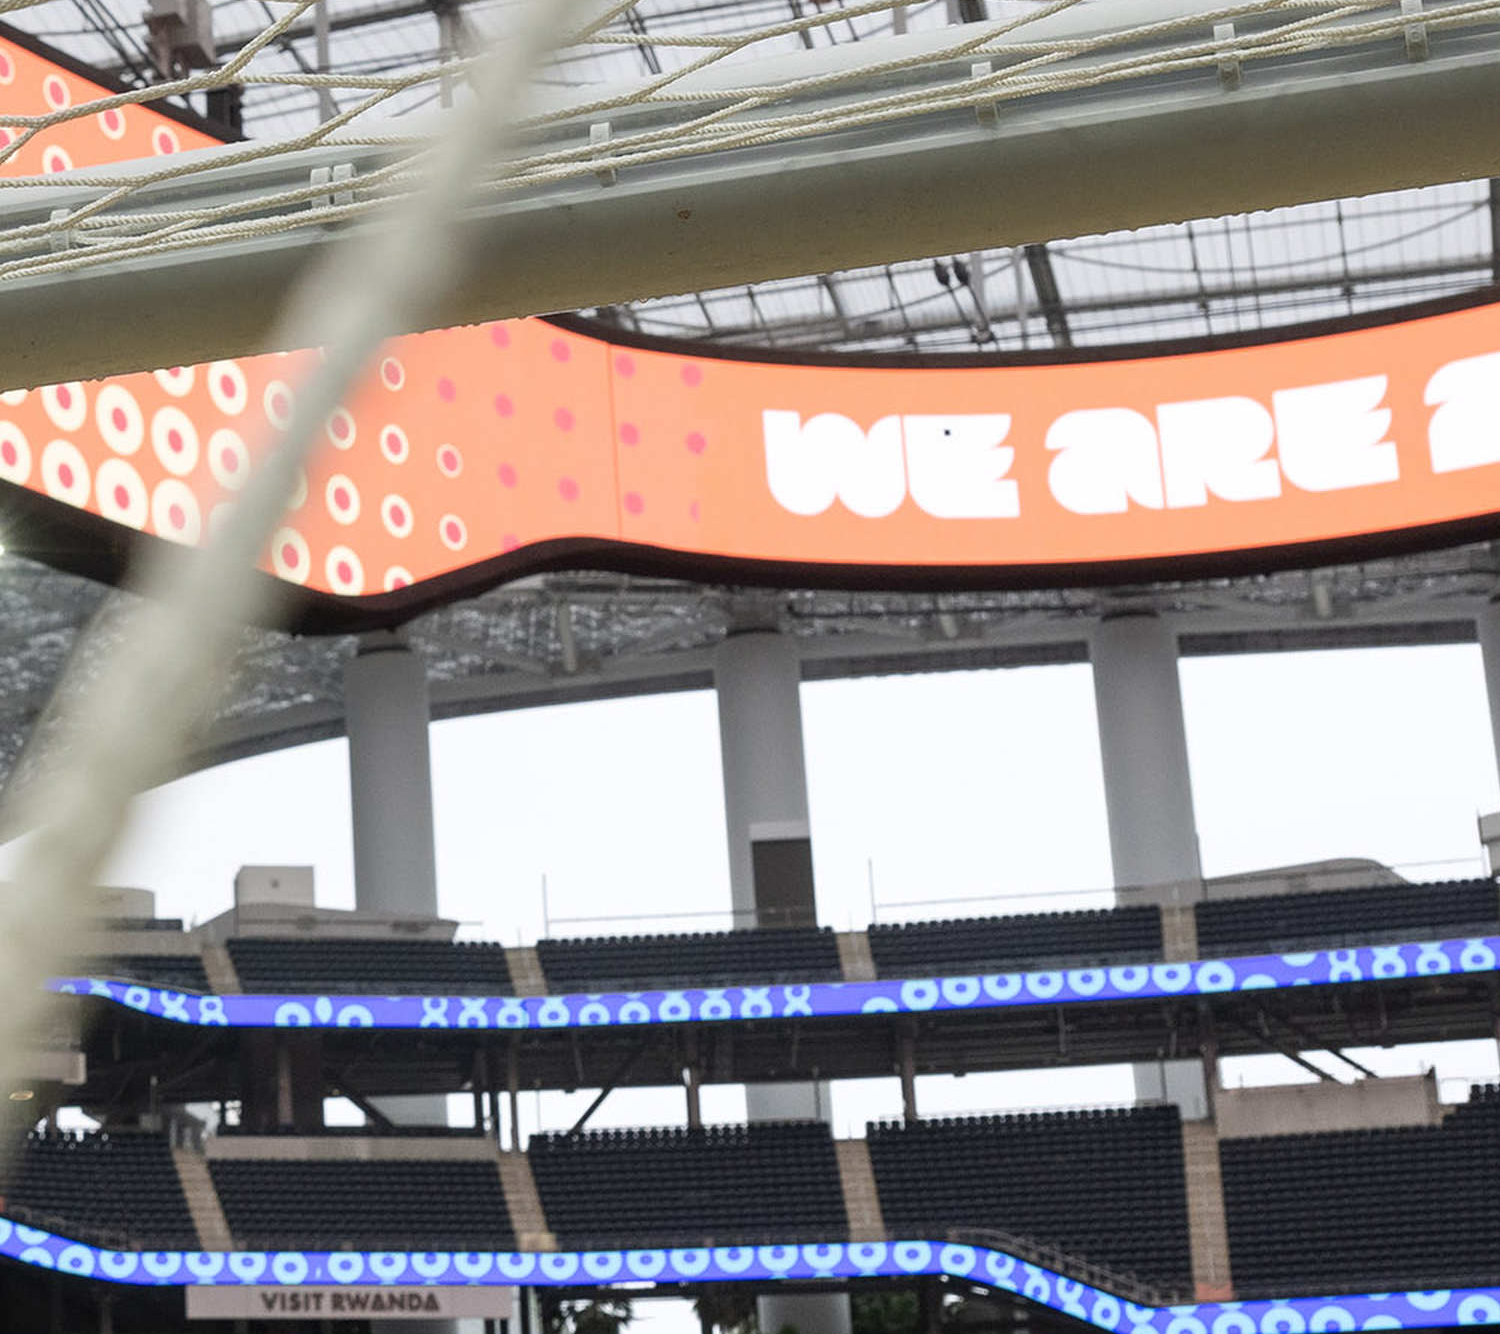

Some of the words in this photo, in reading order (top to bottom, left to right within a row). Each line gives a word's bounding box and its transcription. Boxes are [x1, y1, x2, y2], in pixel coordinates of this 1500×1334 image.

[763, 409, 1021, 520] WE
[261, 1291, 324, 1313] VISIT
[331, 1291, 440, 1313] RWANDA
